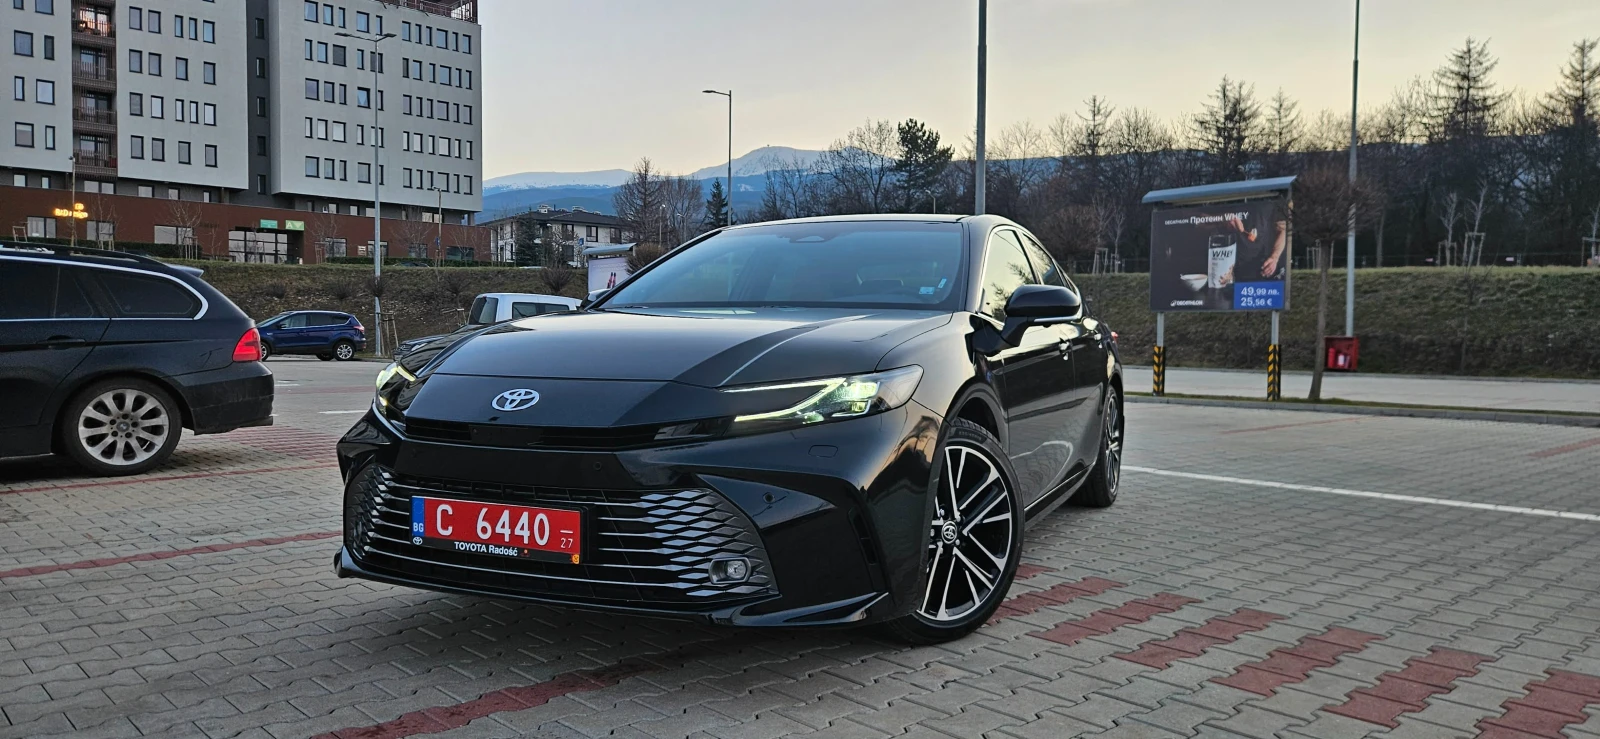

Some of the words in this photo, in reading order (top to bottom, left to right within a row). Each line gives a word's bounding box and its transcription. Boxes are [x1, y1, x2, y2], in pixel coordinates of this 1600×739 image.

[1190, 215, 1223, 225] Протеин
[1224, 211, 1249, 221] WHEY
[1241, 286, 1267, 297] 49,99
[1267, 288, 1280, 296] лв.
[1266, 298, 1273, 306] €
[413, 522, 424, 533] BG
[436, 503, 453, 536] C
[476, 507, 550, 546] 6440
[454, 541, 487, 553] TOYOTA
[488, 545, 518, 556] Radość
[560, 537, 574, 549] 27
